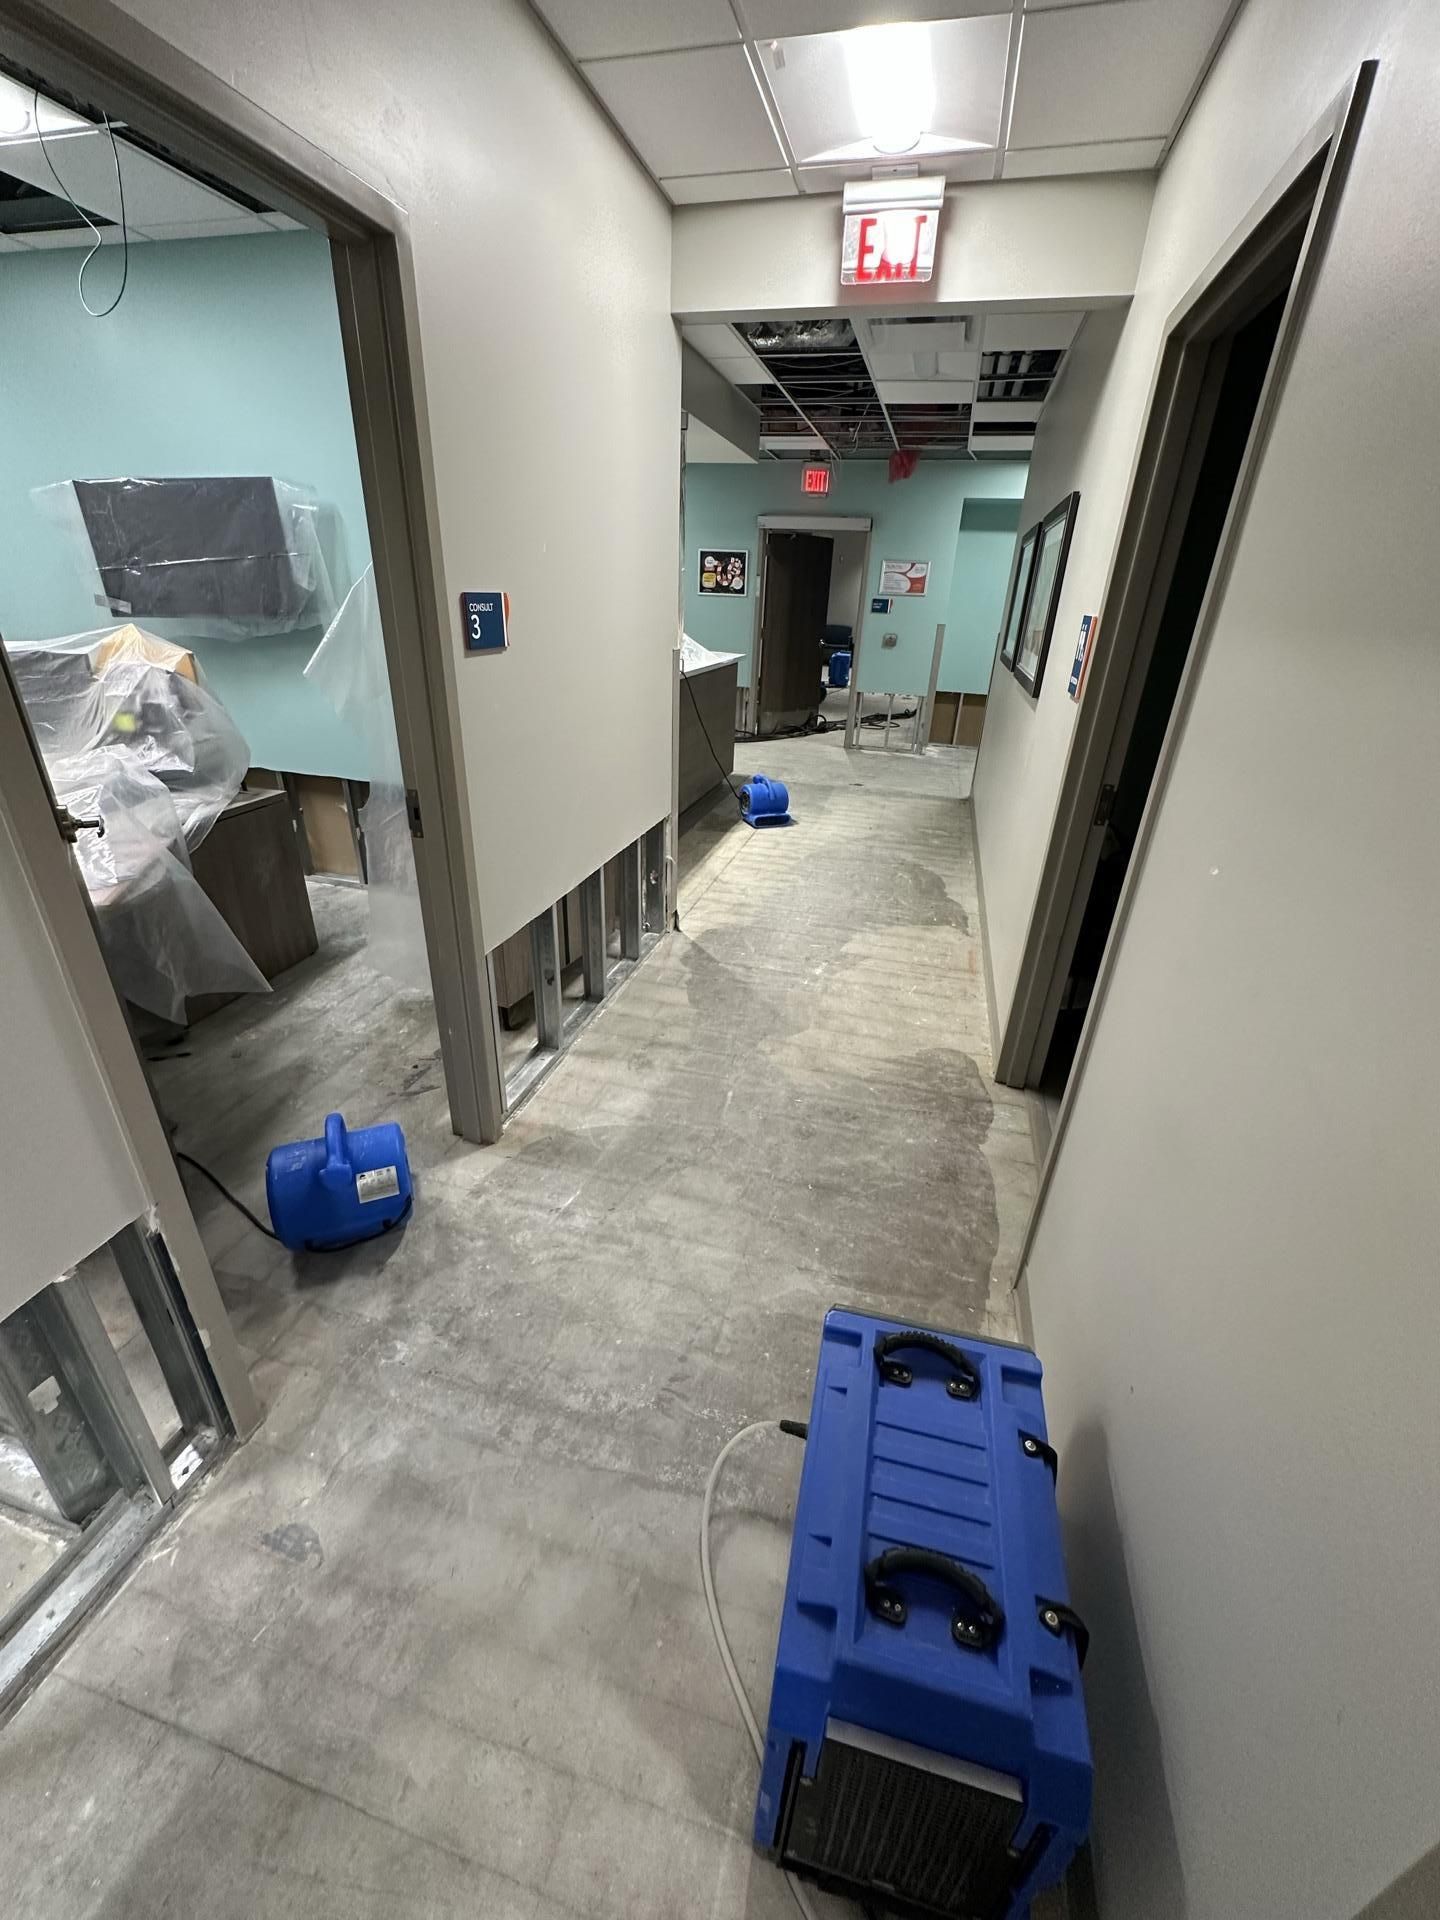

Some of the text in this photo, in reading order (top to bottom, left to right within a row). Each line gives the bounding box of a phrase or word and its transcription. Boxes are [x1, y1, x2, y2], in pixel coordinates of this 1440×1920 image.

[855, 214, 928, 282] ET
[805, 469, 826, 492] EXIT
[468, 602, 494, 612] CONSULT
[470, 614, 482, 640] 3
